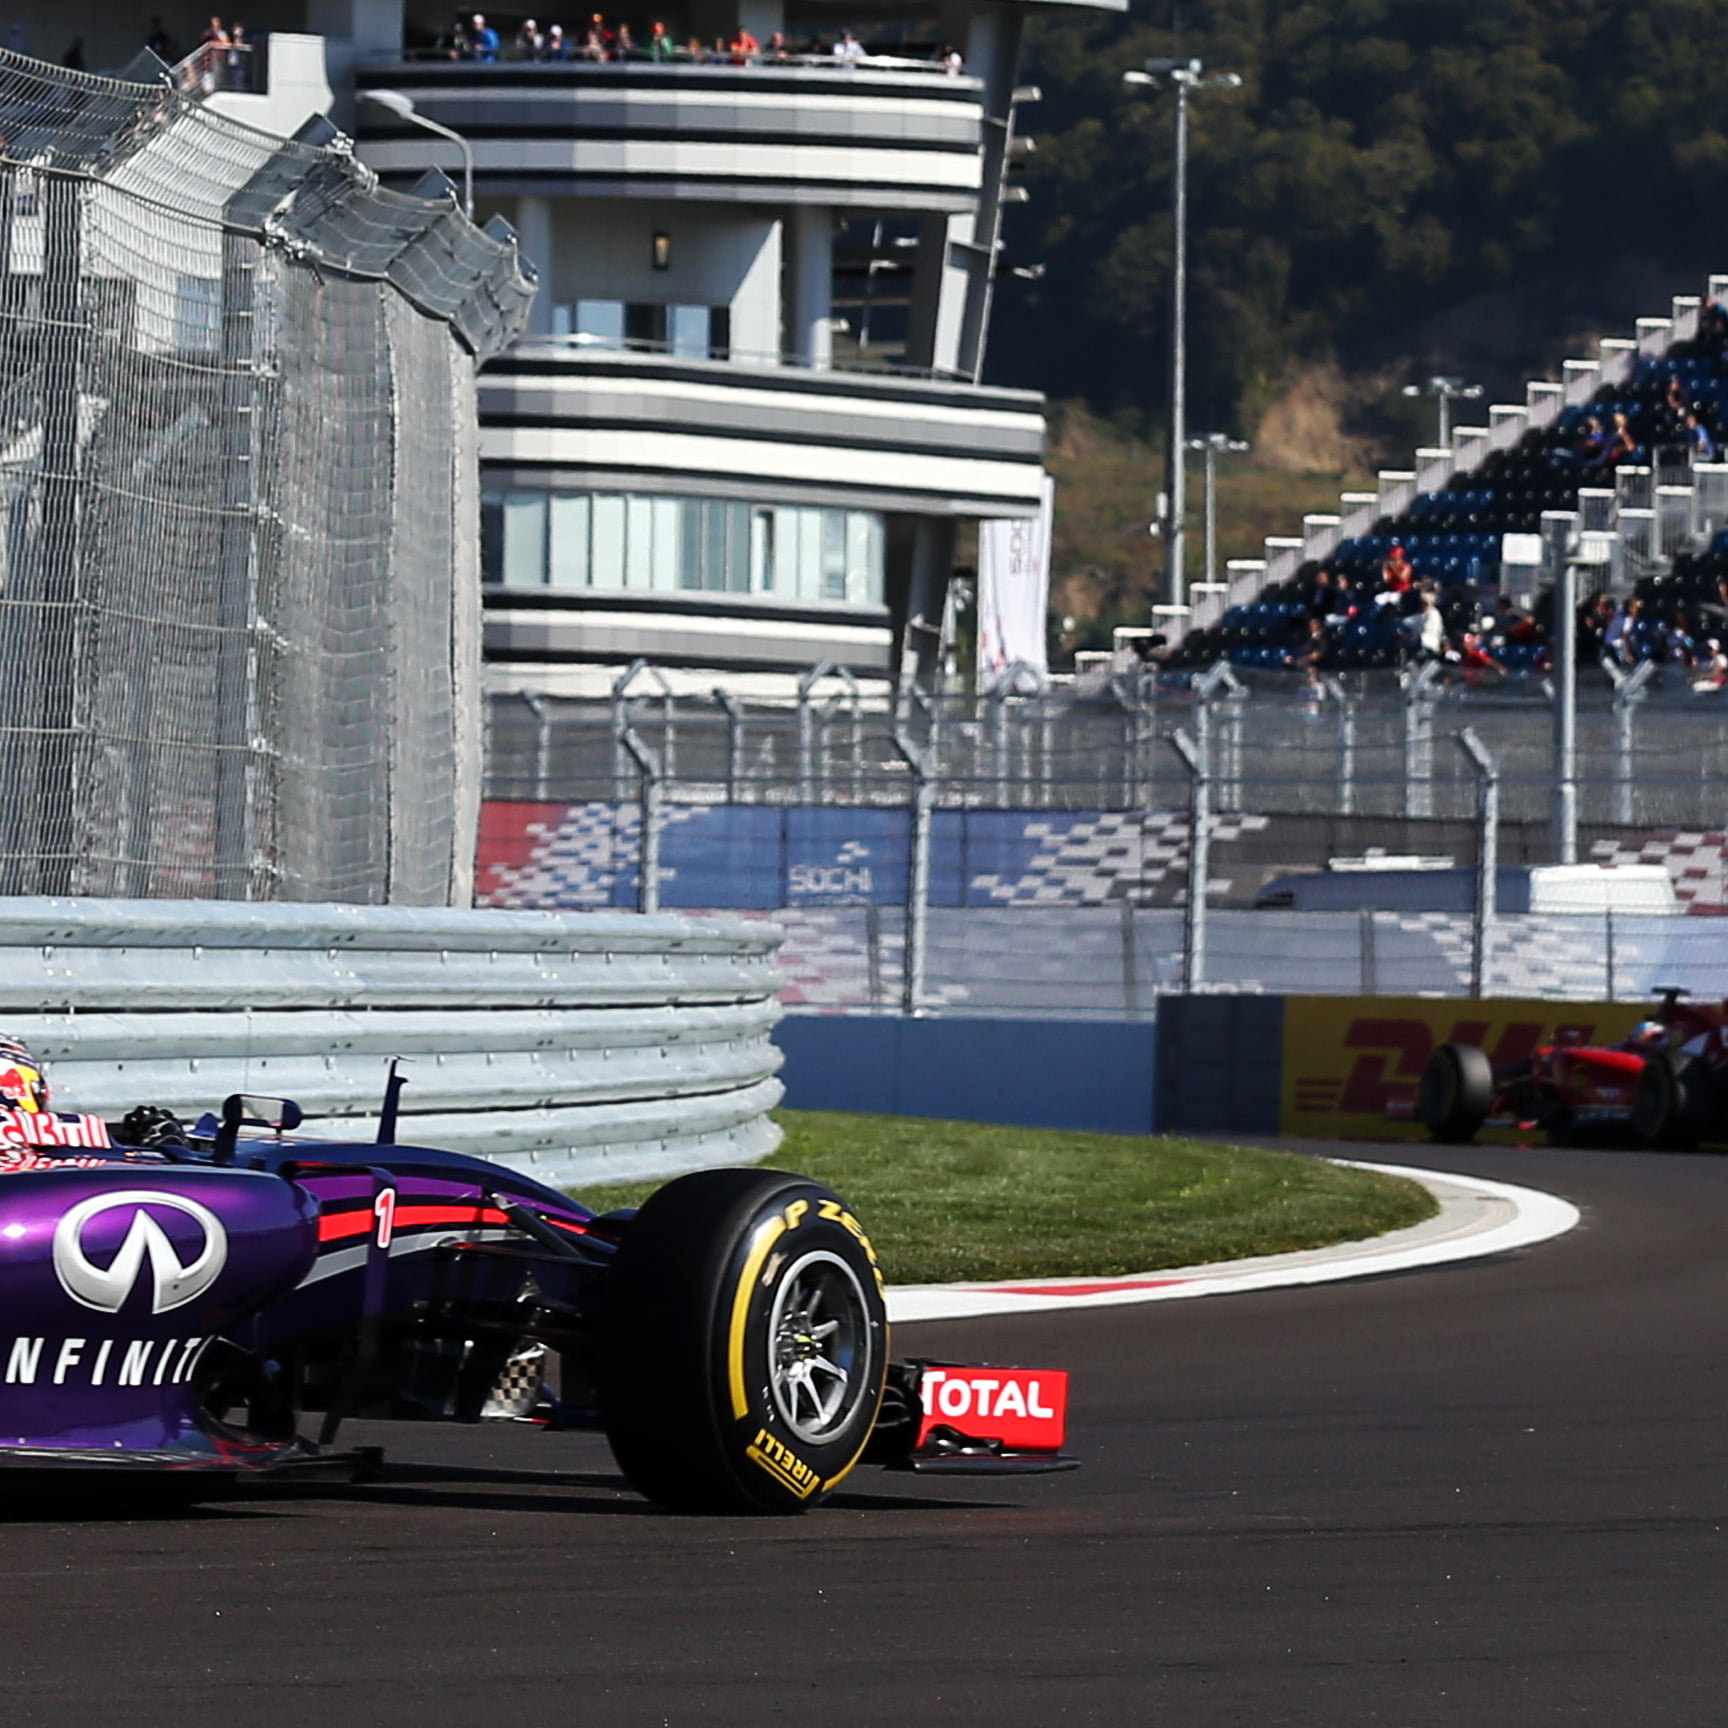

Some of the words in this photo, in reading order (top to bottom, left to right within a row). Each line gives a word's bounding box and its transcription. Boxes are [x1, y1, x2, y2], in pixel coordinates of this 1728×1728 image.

[374, 1187, 396, 1249] 1
[784, 1199, 809, 1230] P
[920, 1371, 1054, 1418] TOTAL
